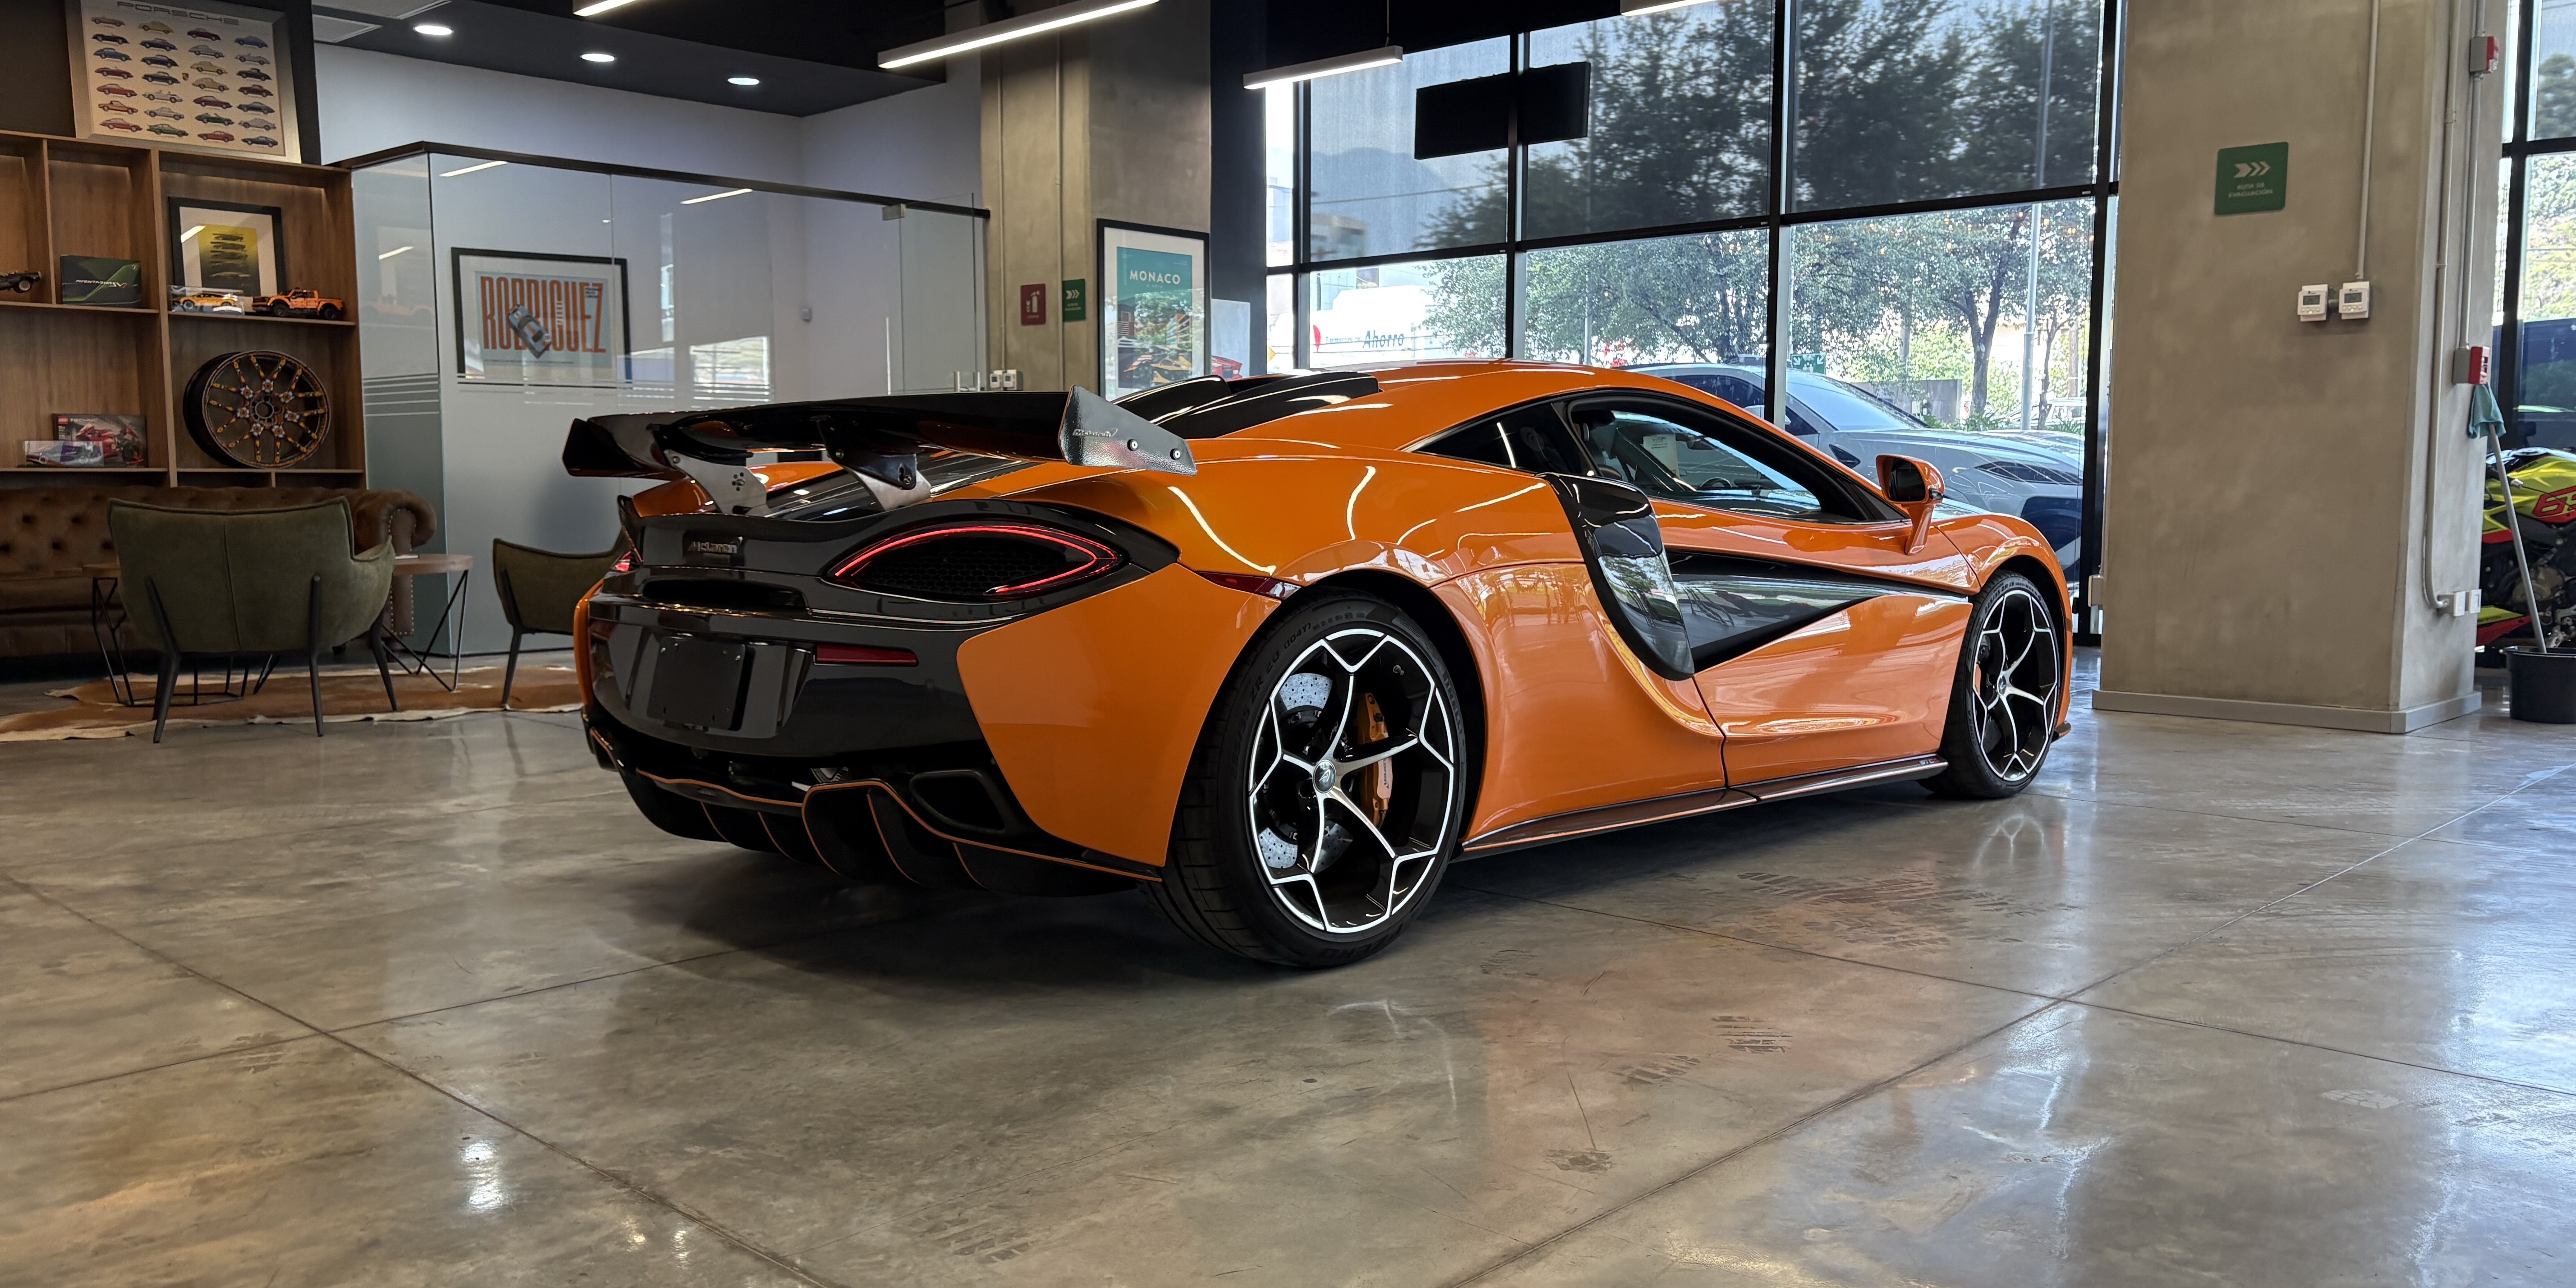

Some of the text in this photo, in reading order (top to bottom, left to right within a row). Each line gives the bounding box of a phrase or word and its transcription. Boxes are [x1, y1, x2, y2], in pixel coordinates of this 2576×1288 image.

[117, 1, 239, 25] PORSCHE
[1130, 270, 1180, 285] MONACO
[1362, 330, 1403, 348] Ahorro
[688, 541, 738, 554] McLaren
[1250, 676, 1264, 704] ZR
[1284, 623, 1311, 649] (104Y)
